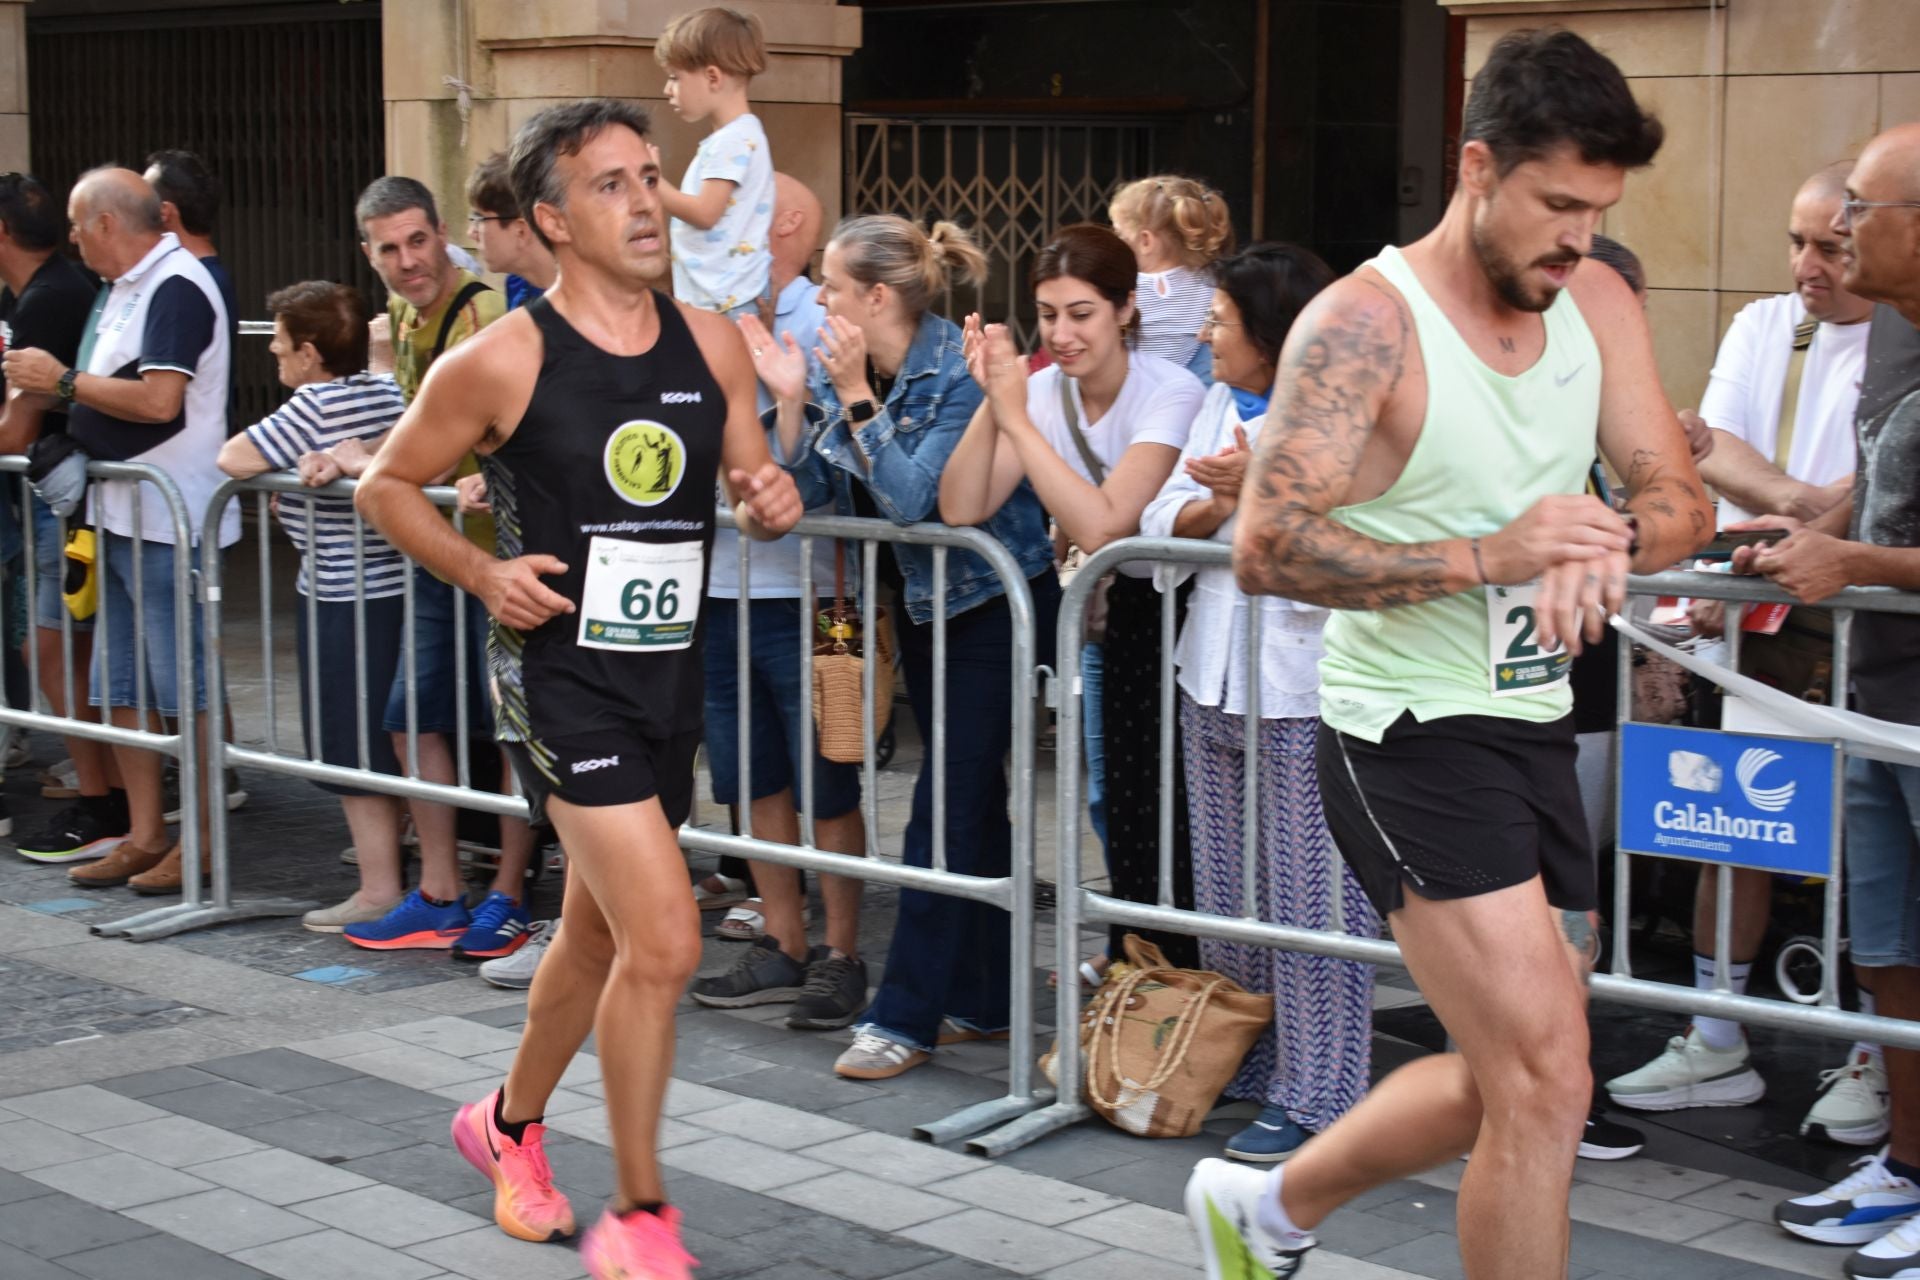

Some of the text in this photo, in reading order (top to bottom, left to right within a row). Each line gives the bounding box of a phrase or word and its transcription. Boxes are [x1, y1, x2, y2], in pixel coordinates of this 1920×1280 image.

[620, 578, 680, 621] 66
[1653, 800, 1797, 844] Calahorra
[1653, 832, 1733, 853] Ayuntamiento
